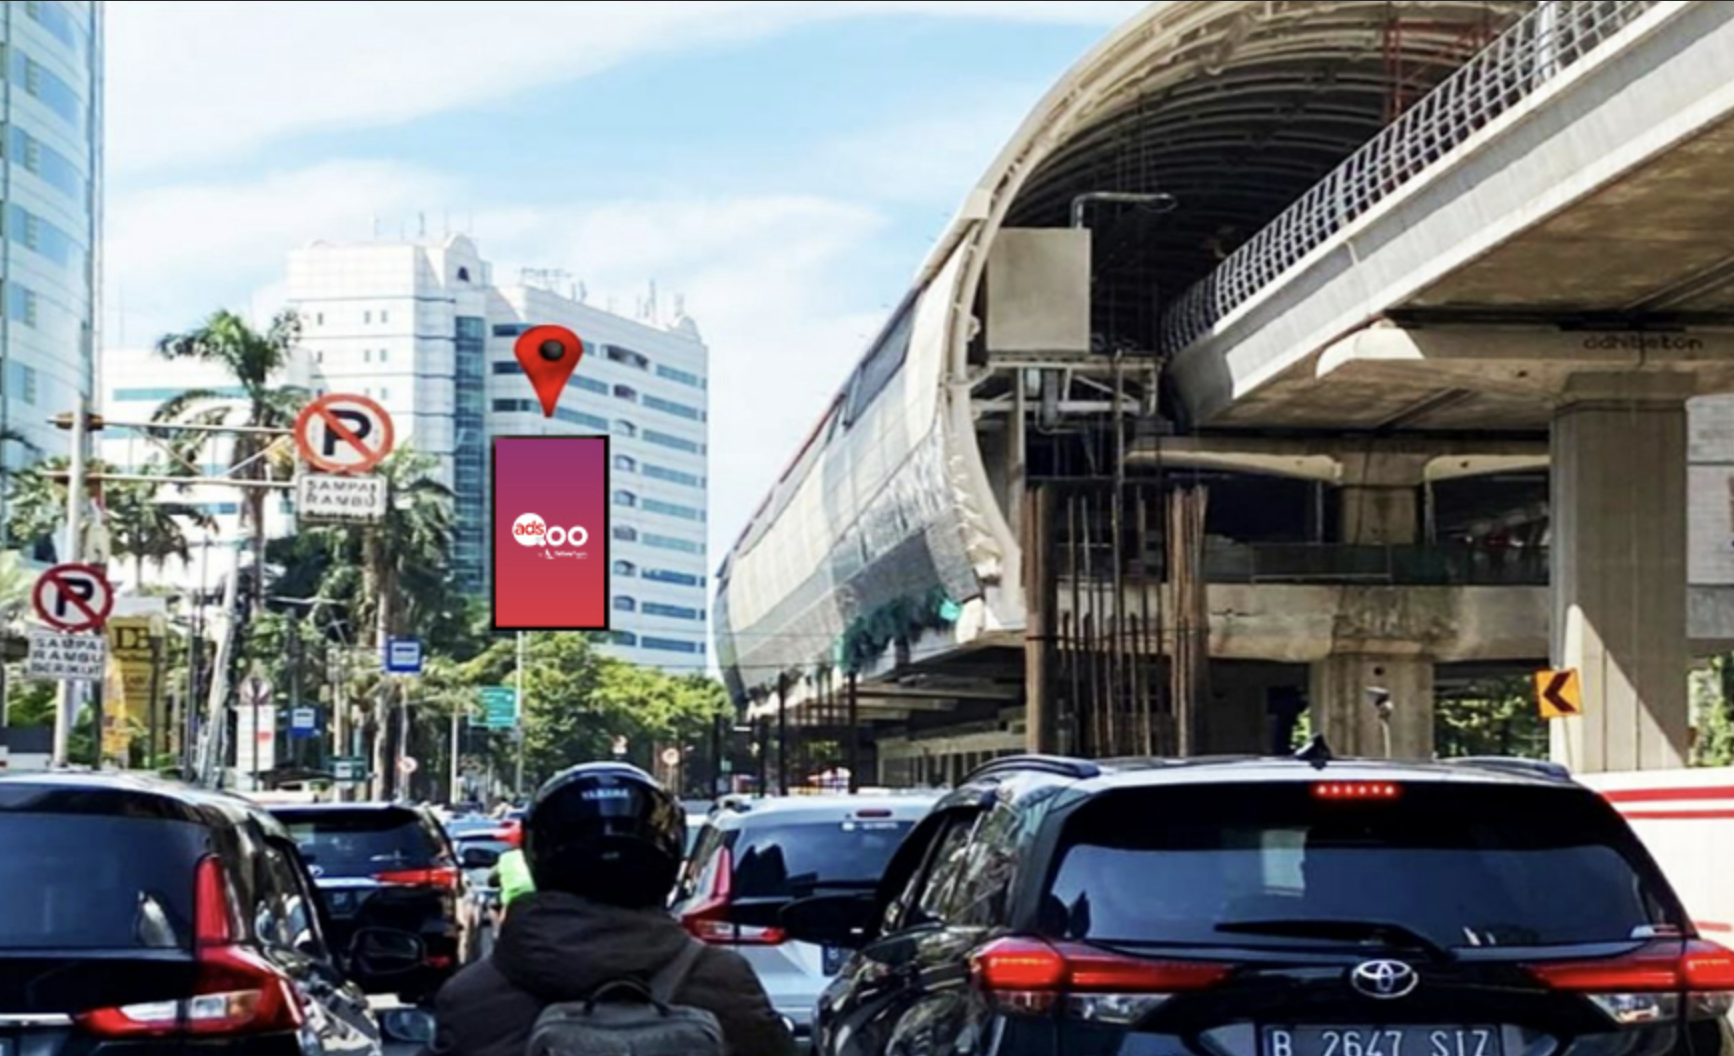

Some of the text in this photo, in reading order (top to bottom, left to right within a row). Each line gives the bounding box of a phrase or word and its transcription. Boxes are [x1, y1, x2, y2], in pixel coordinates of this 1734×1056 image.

[307, 480, 377, 492] SAMPAI
[305, 493, 377, 507] RAMBU
[514, 519, 545, 536] ads
[33, 650, 105, 663] RAMBU
[1272, 1030, 1292, 1056] B
[1322, 1030, 1402, 1056] 2647
